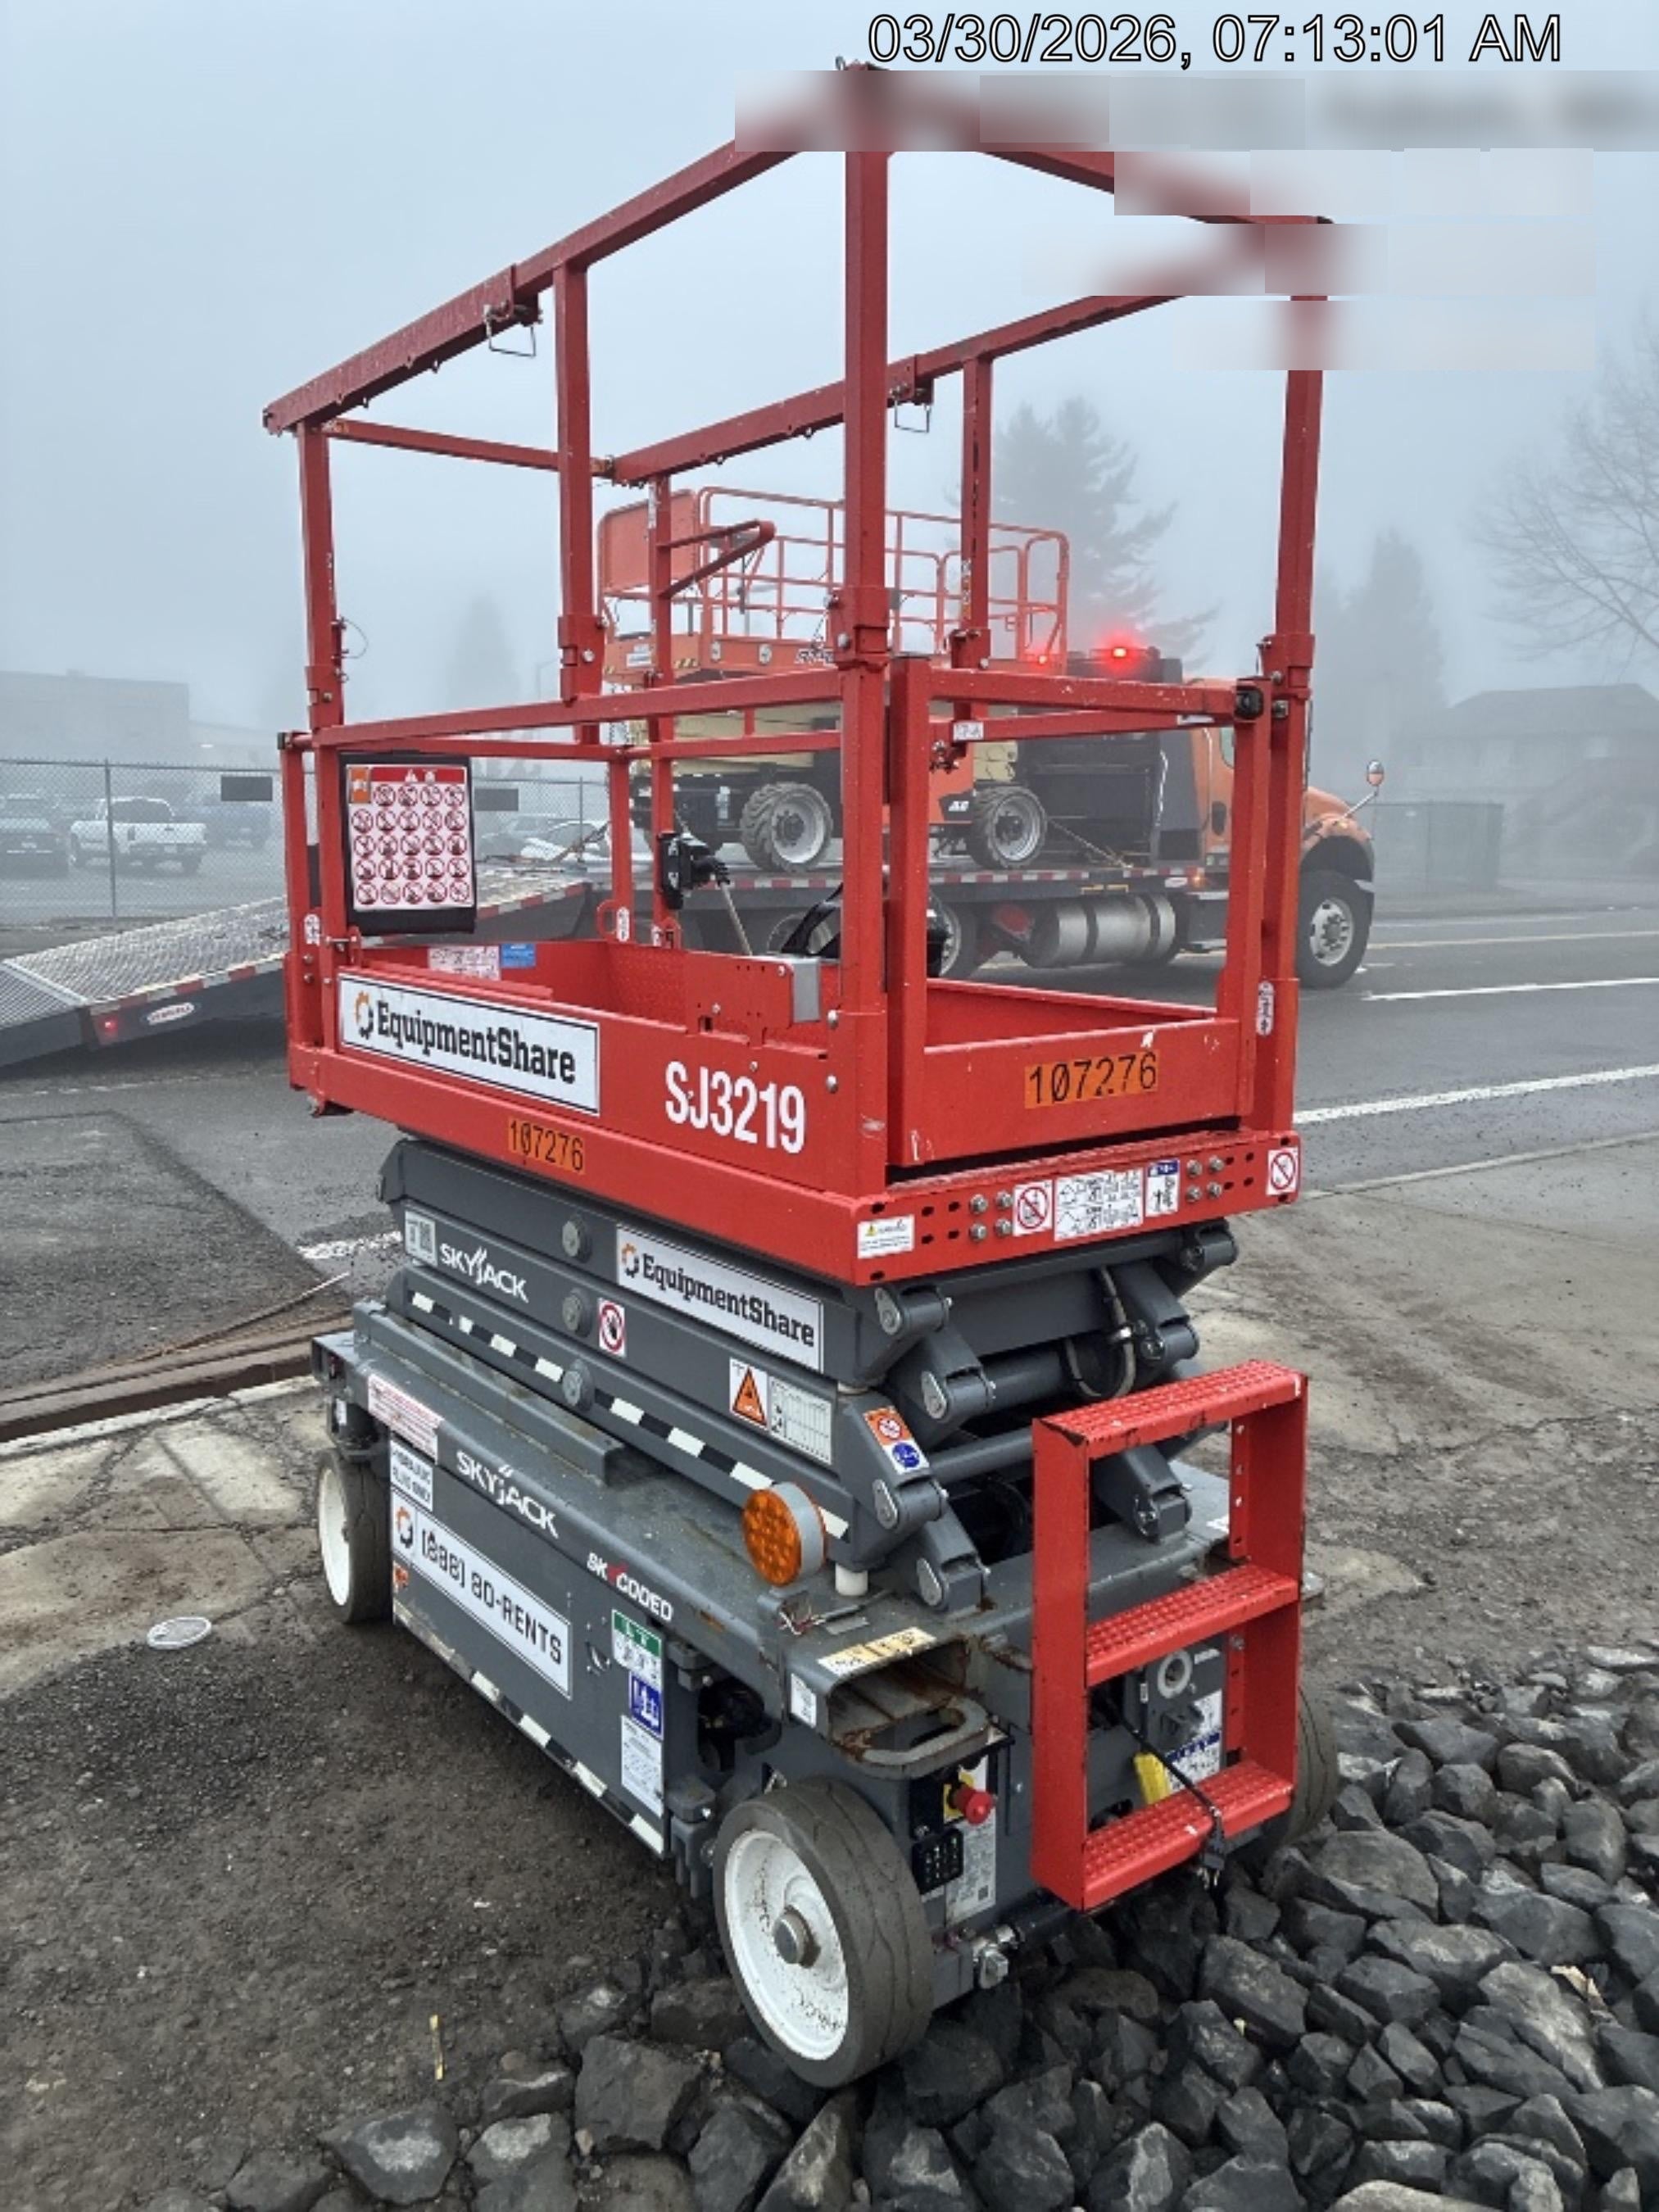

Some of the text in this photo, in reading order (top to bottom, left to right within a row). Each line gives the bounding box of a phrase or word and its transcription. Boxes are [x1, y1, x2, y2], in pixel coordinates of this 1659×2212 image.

[376, 999, 577, 1086] EquipmentShare
[1029, 1050, 1157, 1105] 107276
[510, 1118, 585, 1172] 107276
[664, 1060, 806, 1155] SJ3219
[440, 1243, 528, 1303] SKYJACK
[642, 1251, 816, 1349] EquipmentShare
[456, 1448, 559, 1539] SKYJACK
